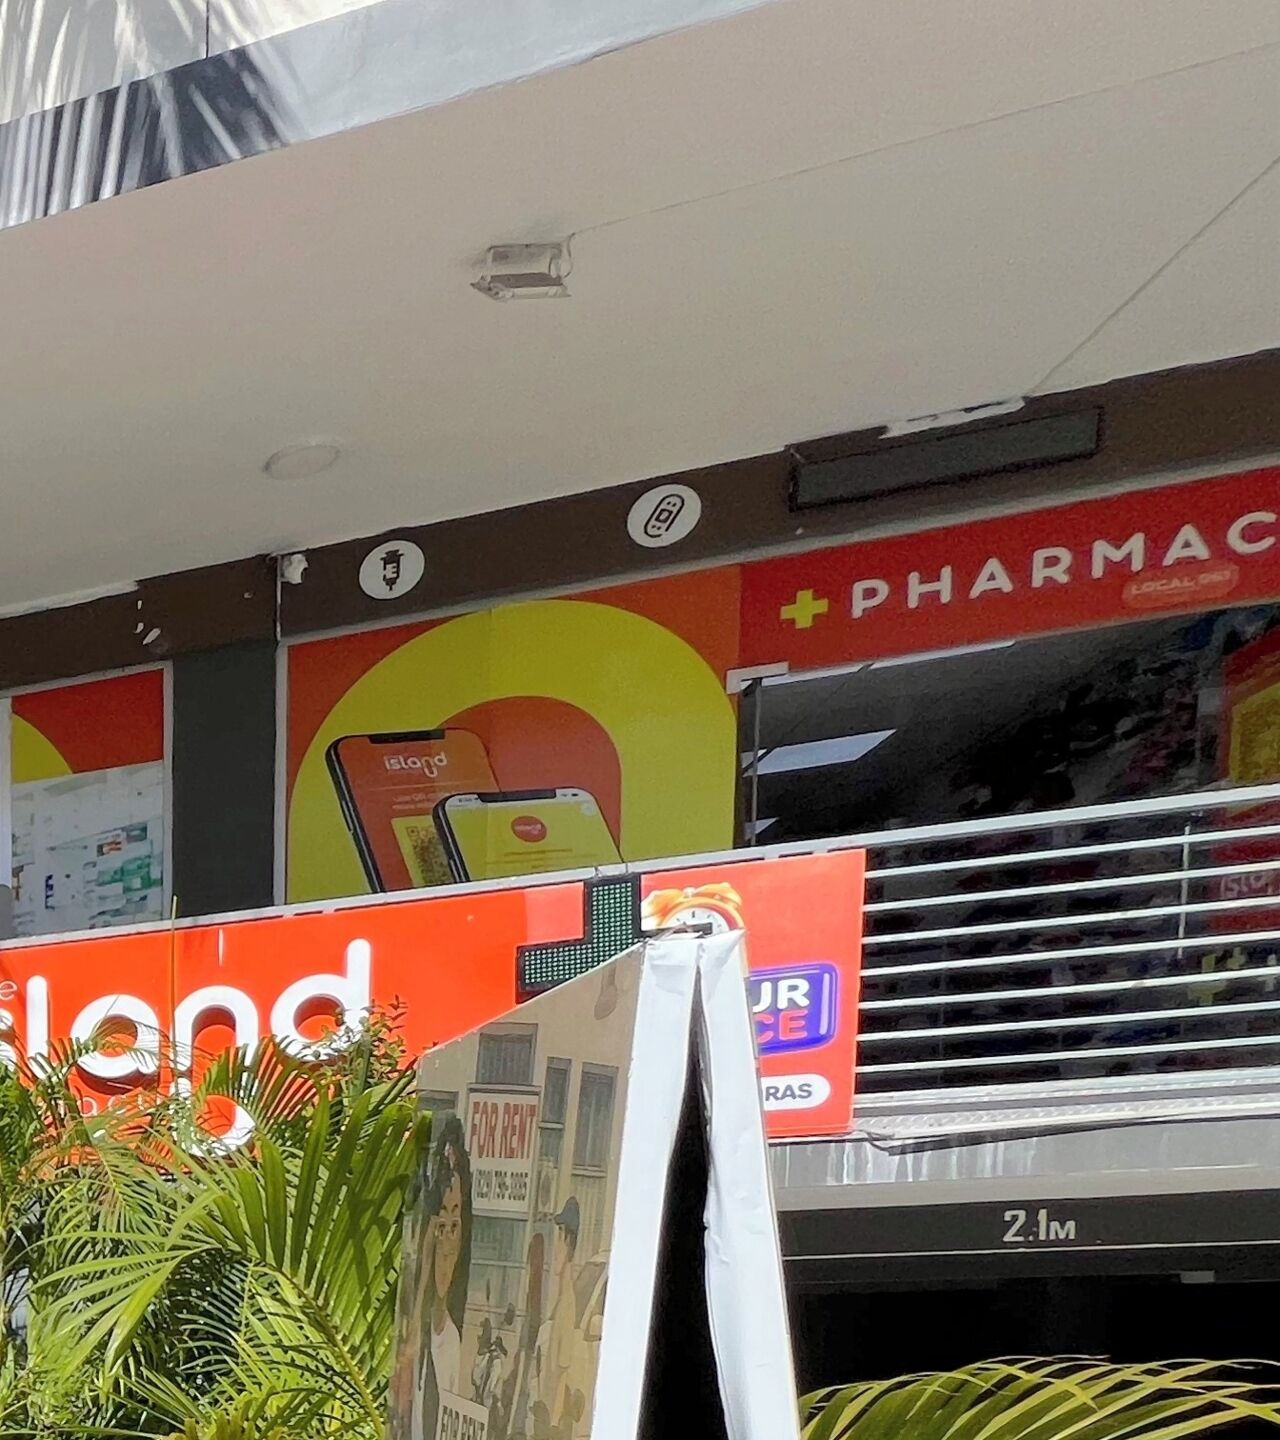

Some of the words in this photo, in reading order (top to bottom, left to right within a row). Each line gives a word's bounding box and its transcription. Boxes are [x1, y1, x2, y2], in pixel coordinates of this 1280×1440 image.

[851, 510, 1279, 619] PHARMAC
[384, 751, 448, 777] island
[765, 1083, 813, 1101] RAS
[470, 1101, 498, 1158] FOR
[499, 1102, 537, 1159] RENT
